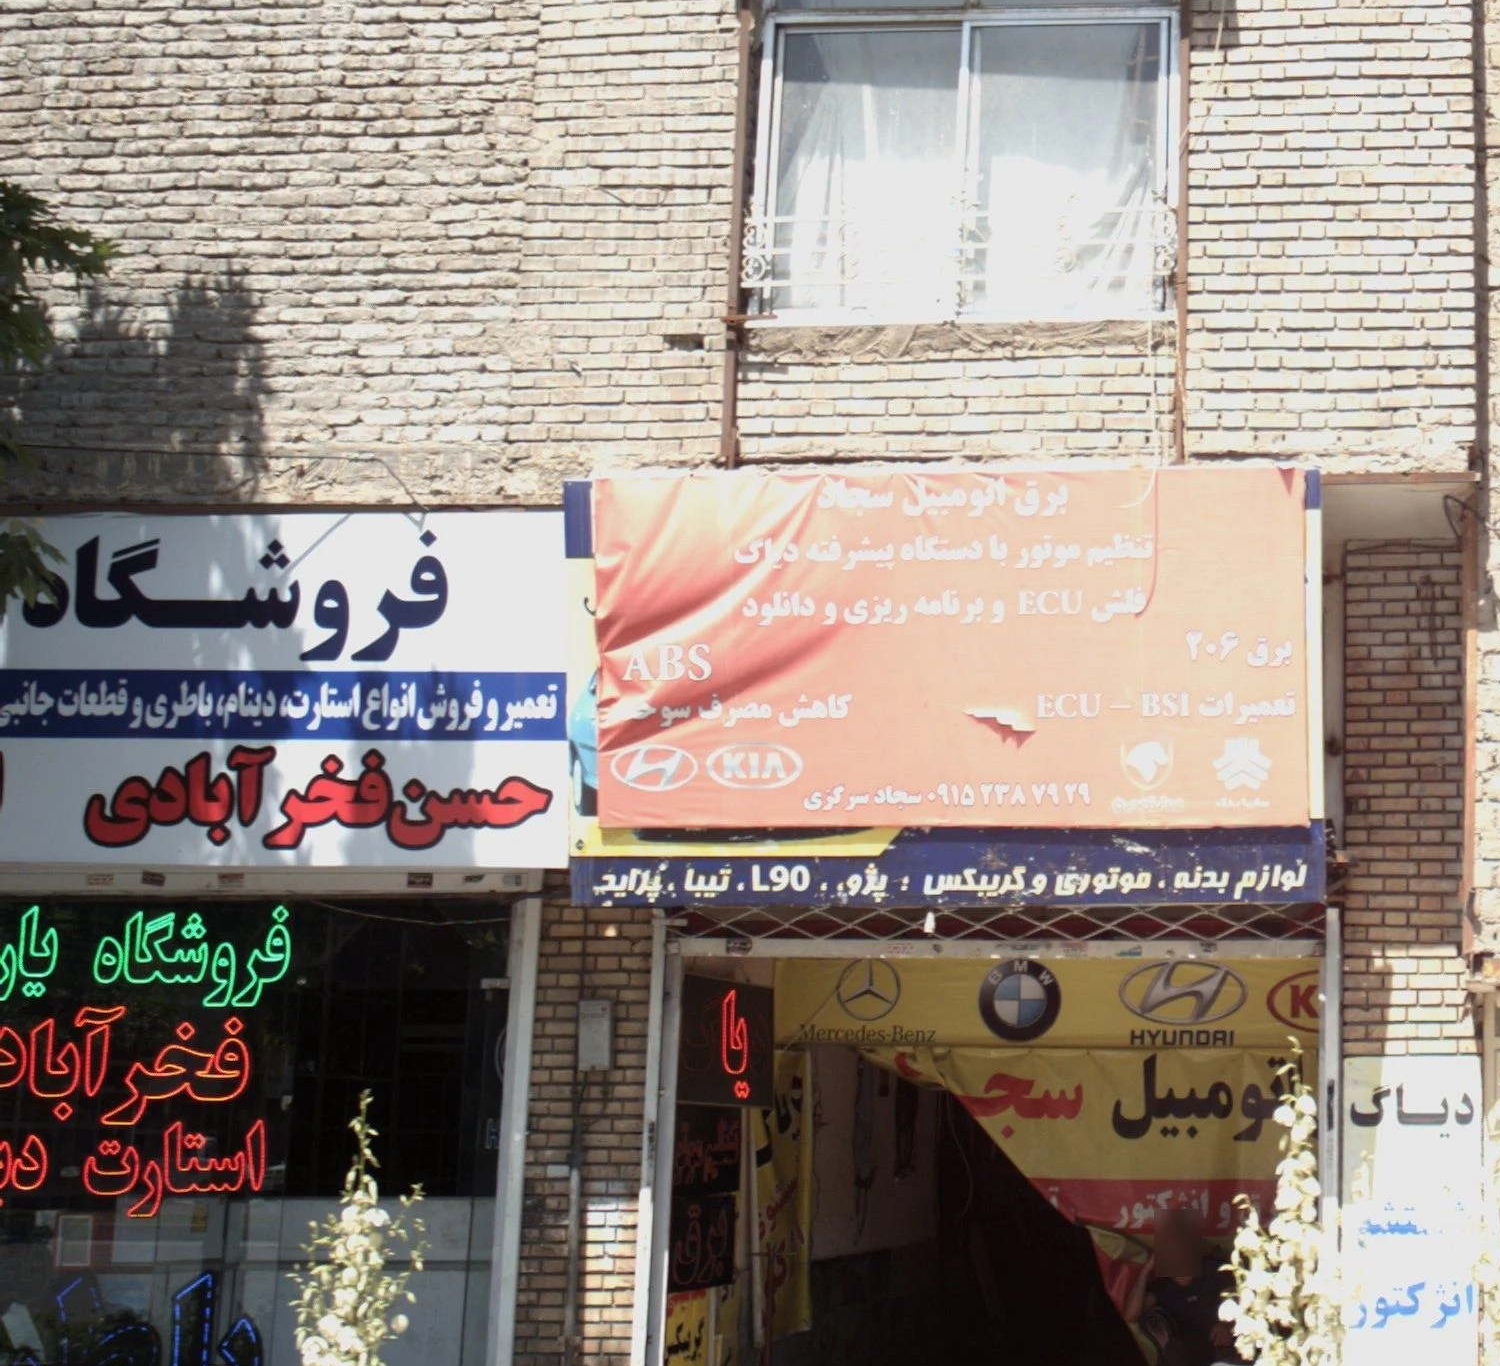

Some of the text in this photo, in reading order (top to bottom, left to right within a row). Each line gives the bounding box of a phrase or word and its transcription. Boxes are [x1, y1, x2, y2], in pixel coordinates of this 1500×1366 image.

[816, 477, 1069, 517] برق اتومبیل سجاد
[805, 535, 895, 571] پیشرفته
[901, 537, 982, 562] دستگاه
[989, 535, 1009, 563] با
[1015, 536, 1080, 569] موتور
[1087, 534, 1154, 567] تنظیم
[22, 529, 449, 662] فروشگاه
[742, 588, 816, 625] دانلود
[821, 598, 838, 625] و
[914, 588, 985, 625] برنامه
[990, 598, 1007, 625] و
[1017, 590, 1084, 615] ECU
[1091, 586, 1148, 623] فلش
[621, 642, 713, 682] ABS
[1185, 630, 1293, 668] برق ۲۰۶
[0, 680, 55, 728] جانبی
[57, 678, 129, 717] قطعات
[129, 695, 144, 729] و
[144, 680, 214, 729] باطری
[361, 681, 417, 731] انواع
[416, 679, 484, 732] فروش
[484, 697, 499, 732] و
[499, 683, 559, 732] تعمیر
[698, 692, 772, 728] مصرف
[778, 693, 853, 728] کاهش
[1036, 690, 1297, 725] تعمیرات ECU BSI
[721, 752, 787, 780] KIA
[84, 745, 553, 850] حسن فخر آبادی
[874, 785, 922, 809] سجاد
[926, 782, 976, 807] ۰۹۱۵
[1031, 873, 1048, 896] و
[1233, 863, 1308, 900] لوازم
[93, 905, 291, 1007] فروشگاه
[800, 1023, 937, 1044] Mercedes-Benz
[1130, 1029, 1235, 1047] HYUNDAI
[0, 1005, 250, 1126] فخر آباد
[1349, 1082, 1476, 1139] دیاگ
[82, 1119, 266, 1218] استارت
[1349, 1280, 1475, 1329] انژکتور
